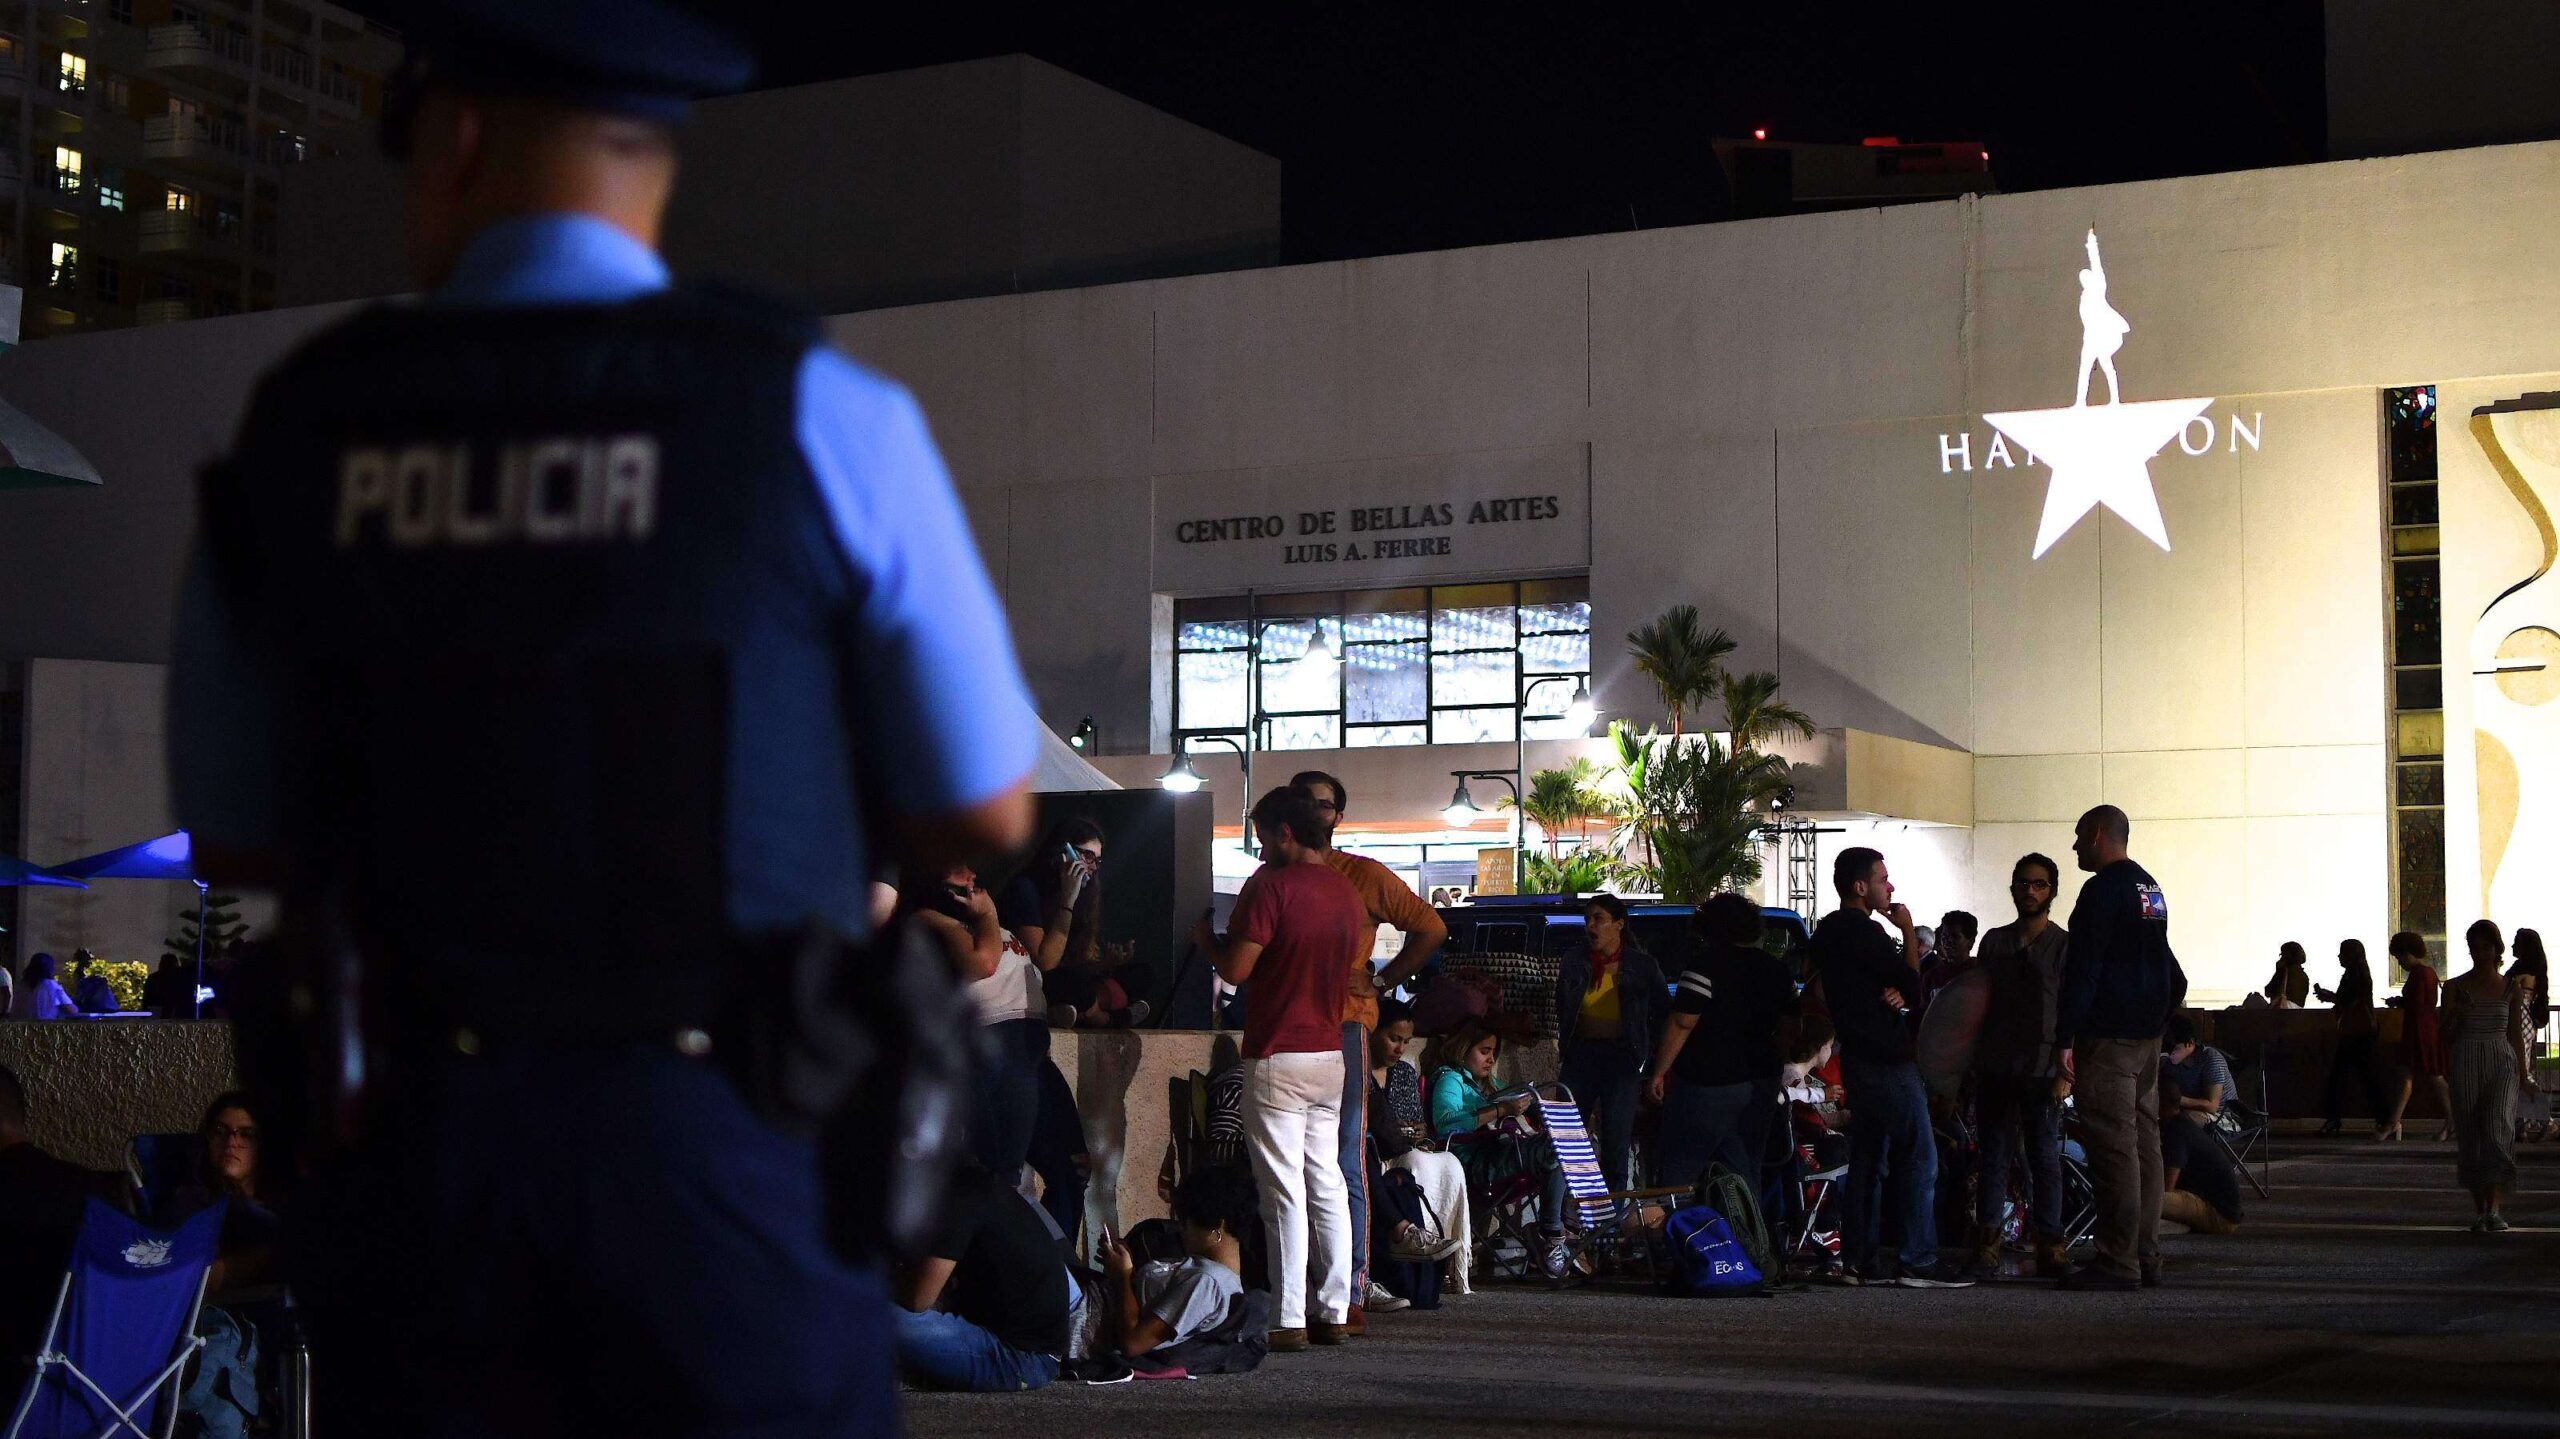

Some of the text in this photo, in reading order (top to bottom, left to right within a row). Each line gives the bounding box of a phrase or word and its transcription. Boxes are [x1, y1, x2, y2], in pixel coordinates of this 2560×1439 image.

[1939, 411, 2263, 474] HAON
[334, 433, 658, 547] POLICIA
[1176, 495, 1560, 544] CENTRO DE BELLAS ARTES
[1283, 536, 1451, 564] LUIS A. FERRE
